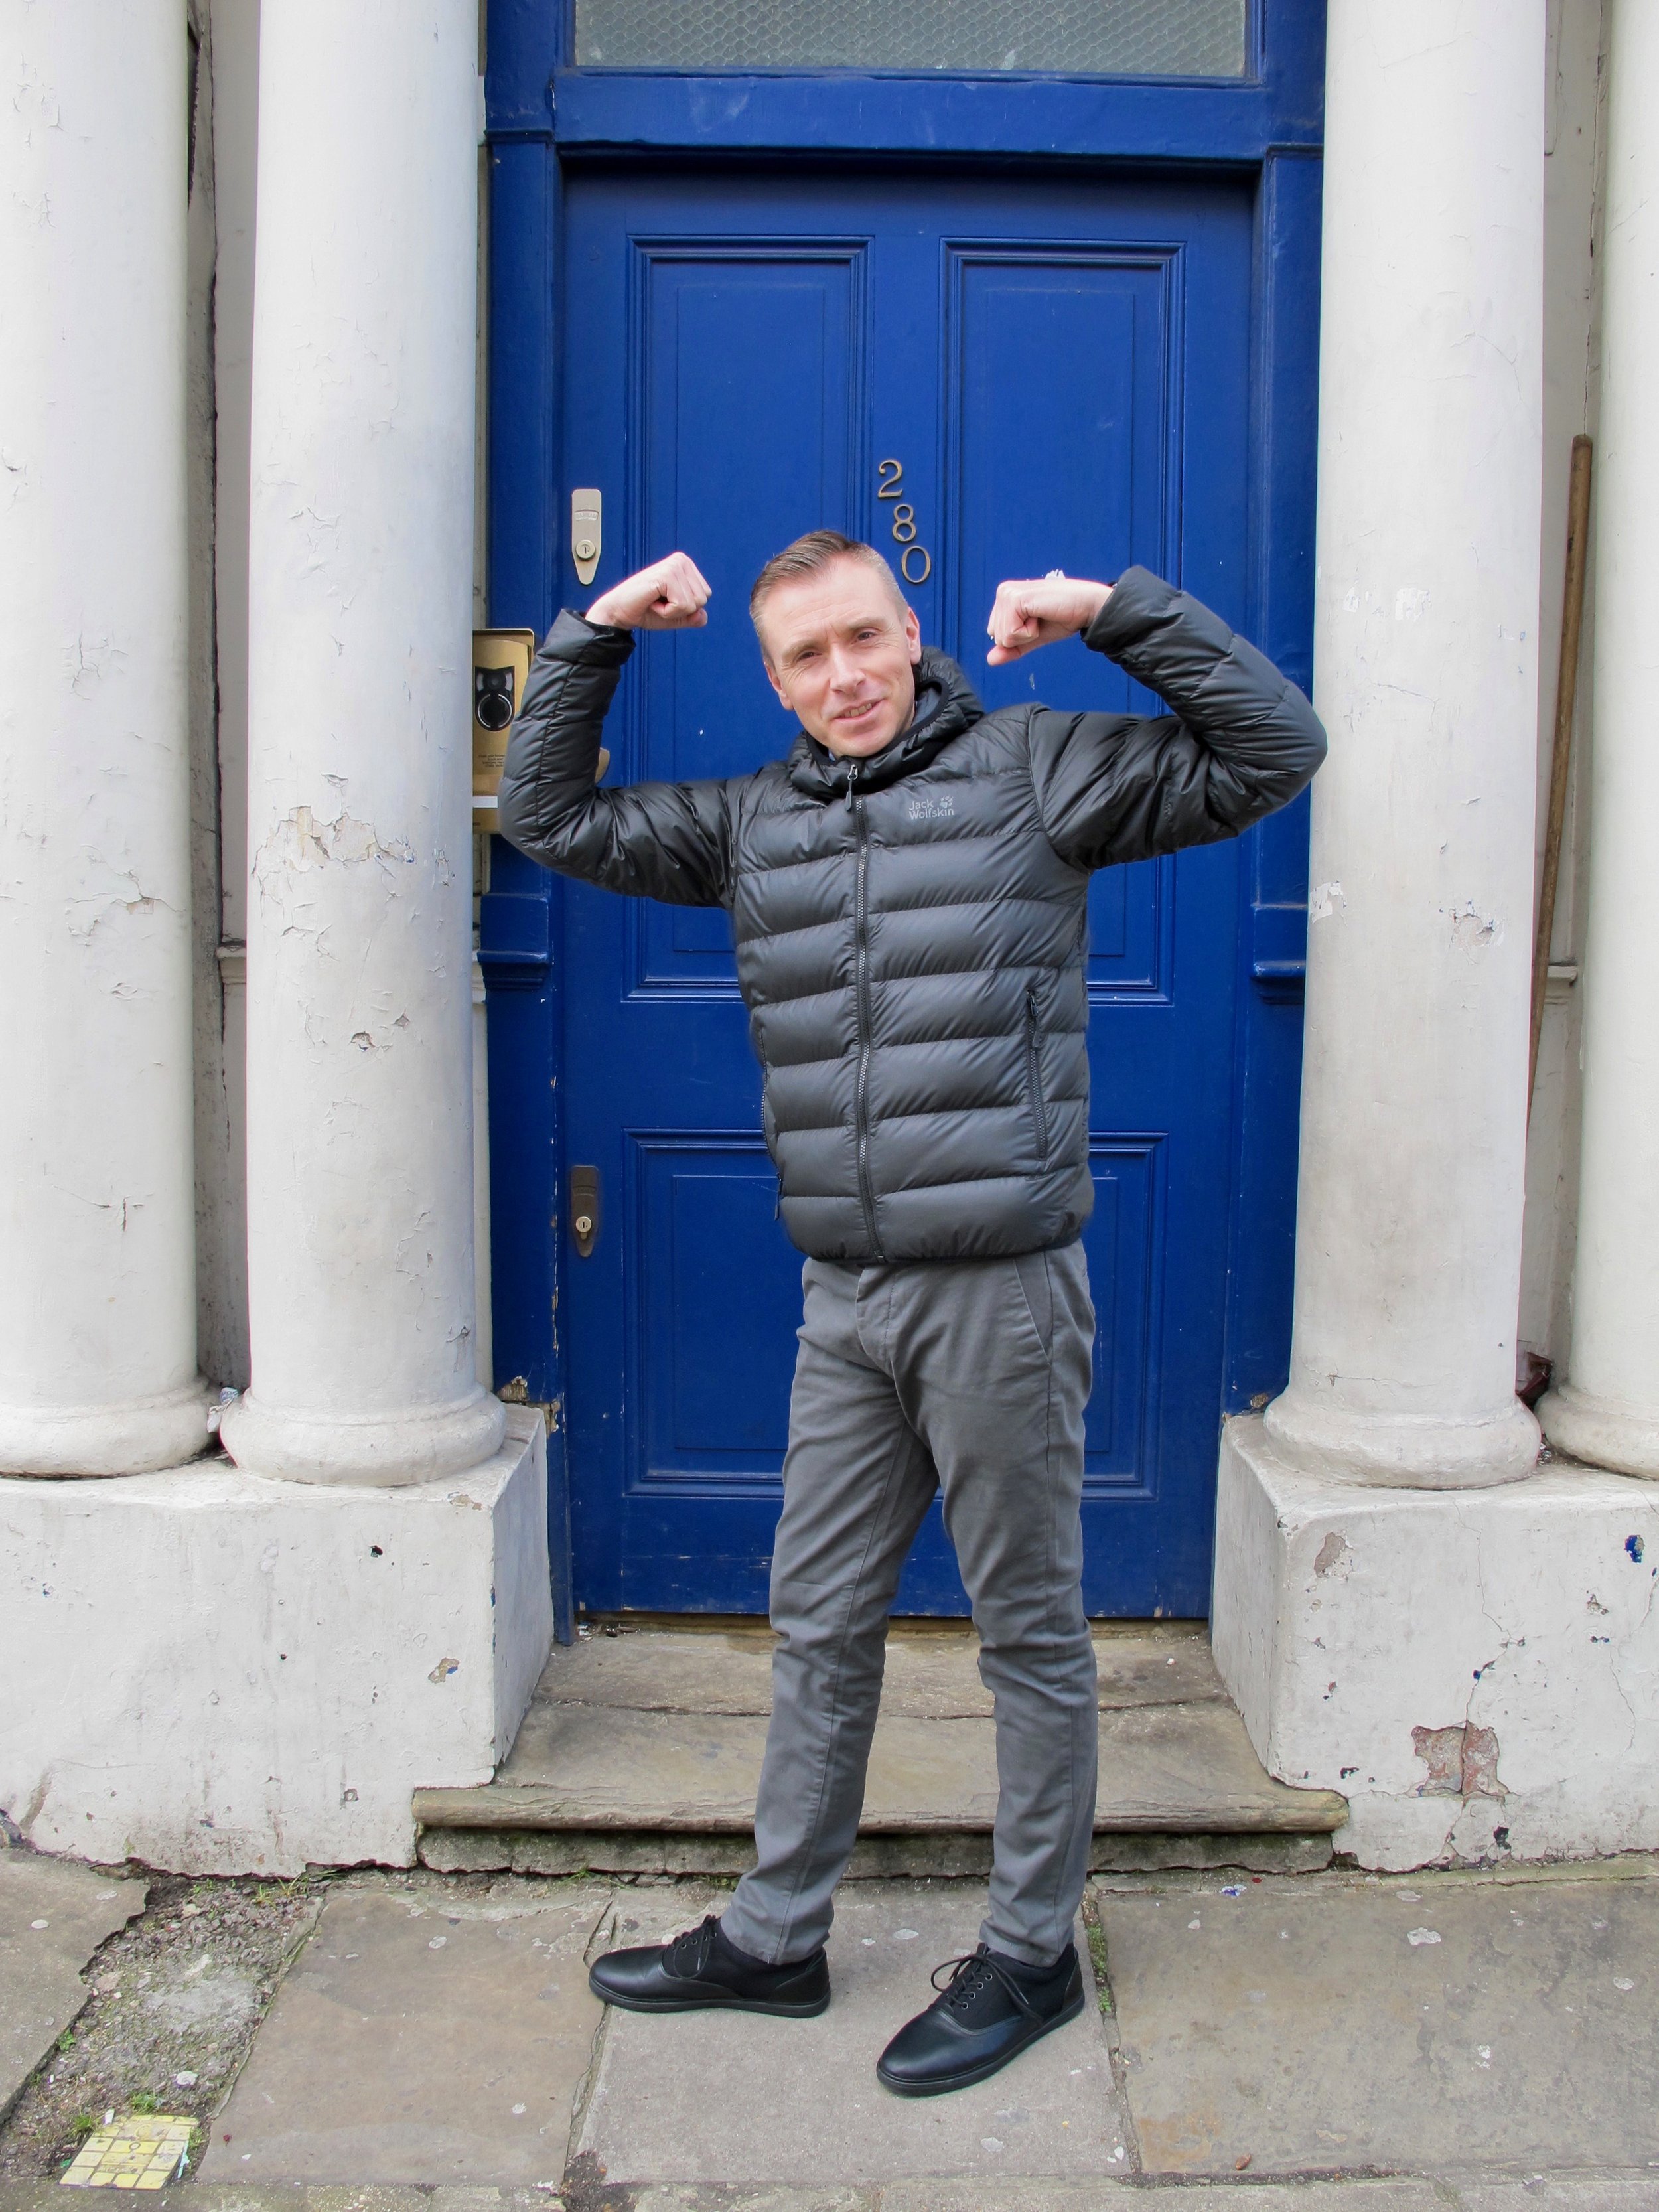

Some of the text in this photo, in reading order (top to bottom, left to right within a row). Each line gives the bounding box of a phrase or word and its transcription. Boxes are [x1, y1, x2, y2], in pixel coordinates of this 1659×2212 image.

[878, 459, 931, 583] 280
[908, 799, 934, 811] Jack
[908, 808, 954, 820] Wolfskin
